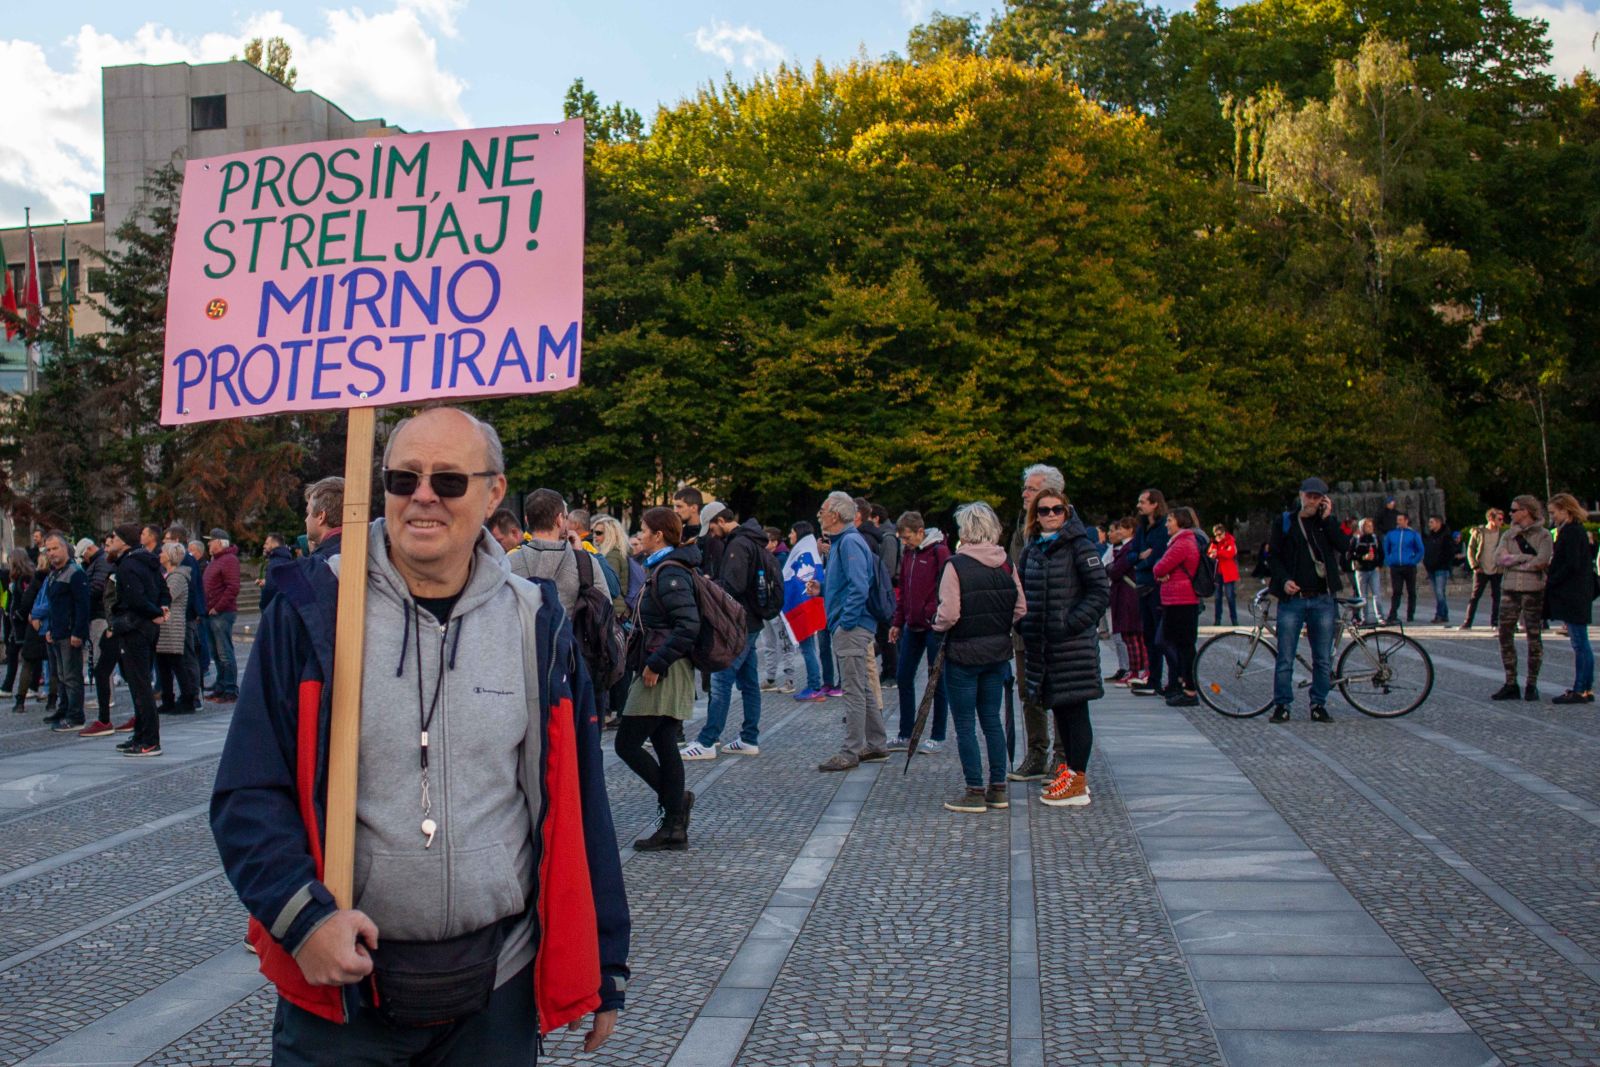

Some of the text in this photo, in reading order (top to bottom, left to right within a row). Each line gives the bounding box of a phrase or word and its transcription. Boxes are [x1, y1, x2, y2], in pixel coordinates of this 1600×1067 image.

[218, 133, 540, 213] PROSIM, NE
[203, 189, 543, 280] STRELJAJ!
[257, 259, 501, 338] MIRNO
[173, 321, 578, 415] PROTESTIRAM
